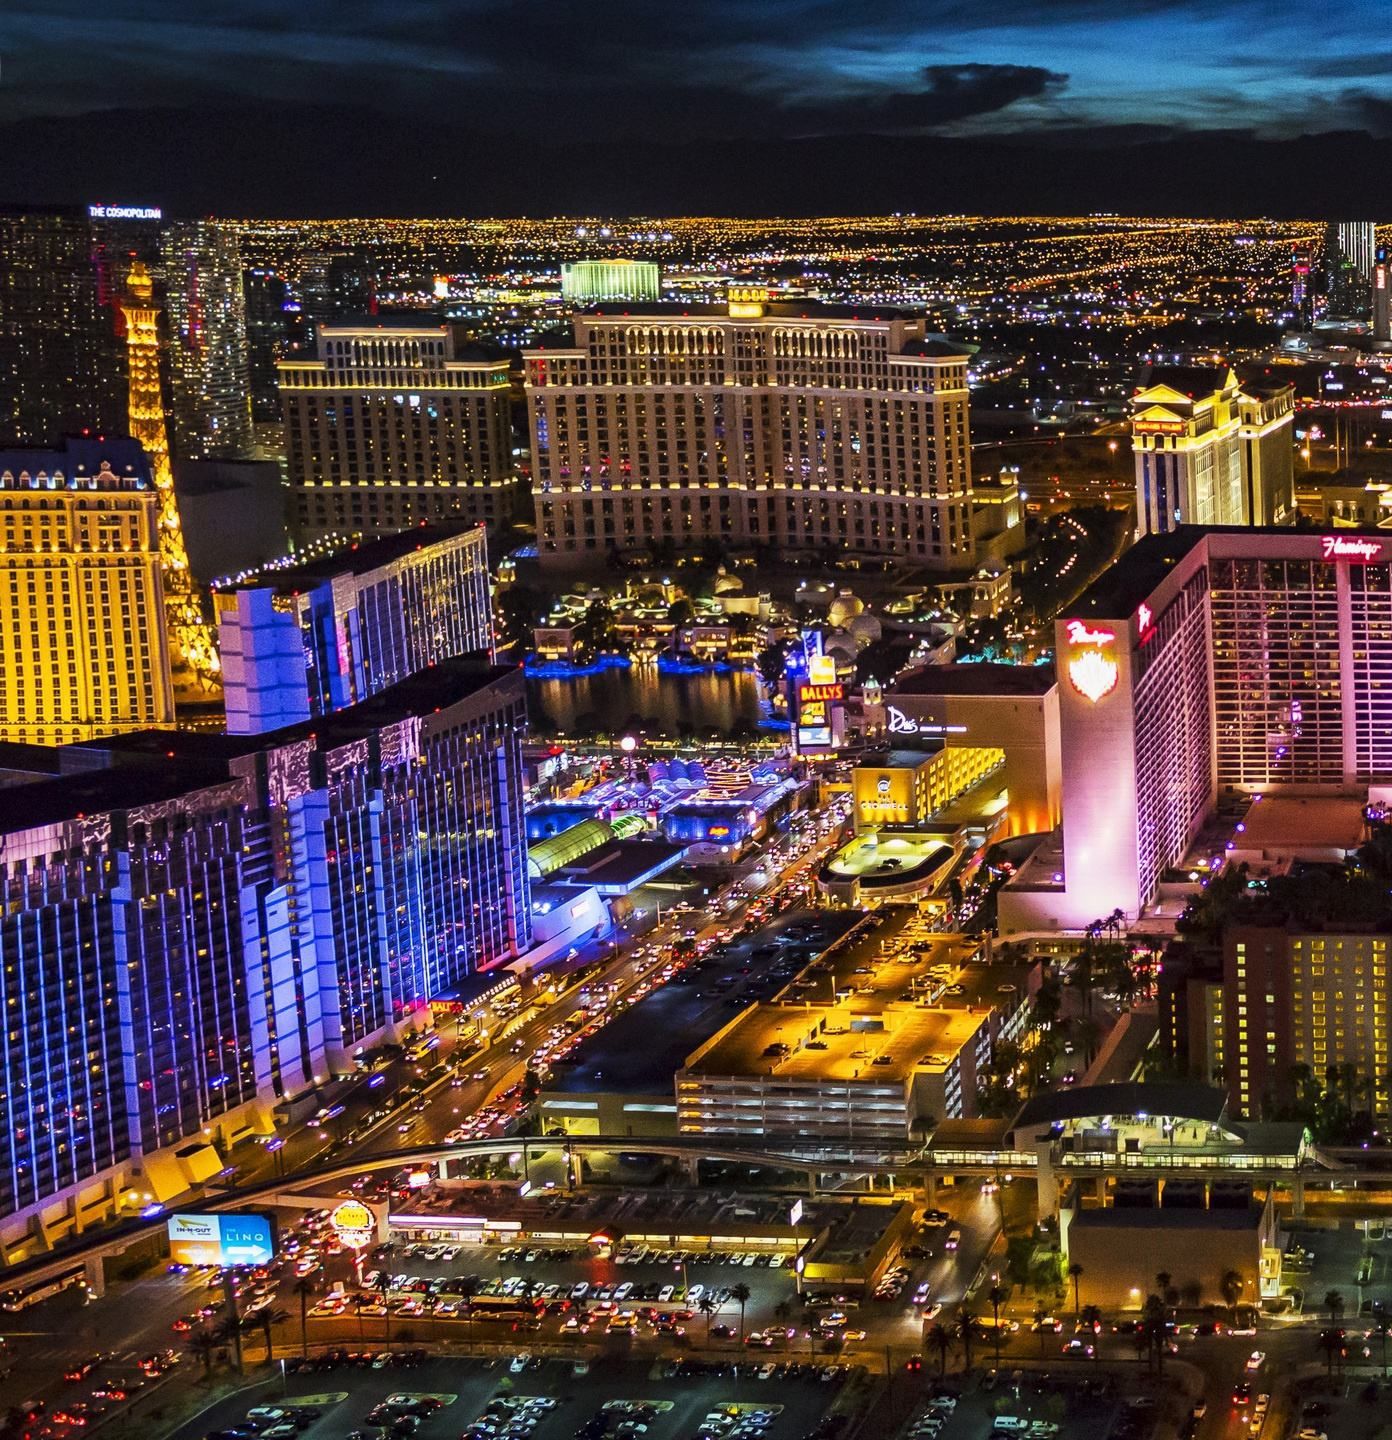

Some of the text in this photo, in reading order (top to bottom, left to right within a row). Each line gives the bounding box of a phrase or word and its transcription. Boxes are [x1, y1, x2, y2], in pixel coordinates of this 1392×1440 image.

[90, 206, 162, 219] THE COSMOPOLITAN
[1322, 536, 1382, 561] Flamingo
[226, 1233, 264, 1242] LINQ
